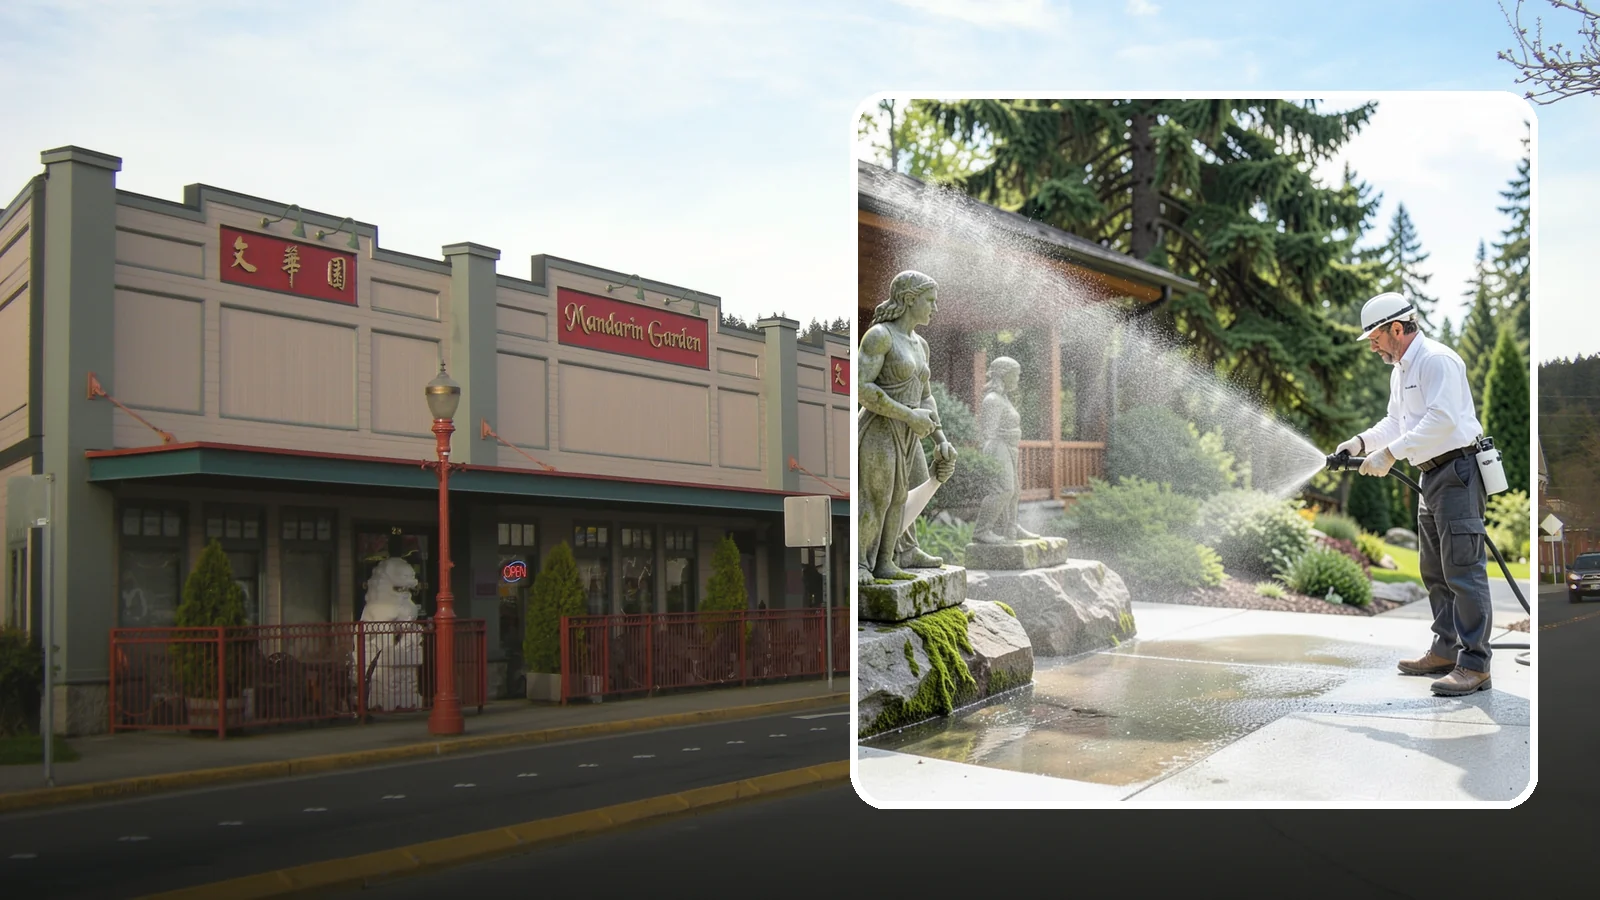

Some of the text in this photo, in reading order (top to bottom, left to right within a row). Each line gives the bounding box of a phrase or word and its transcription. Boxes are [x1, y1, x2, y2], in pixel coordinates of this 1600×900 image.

[564, 302, 701, 352] Mandarin Garden
[503, 565, 527, 578] OPEN
